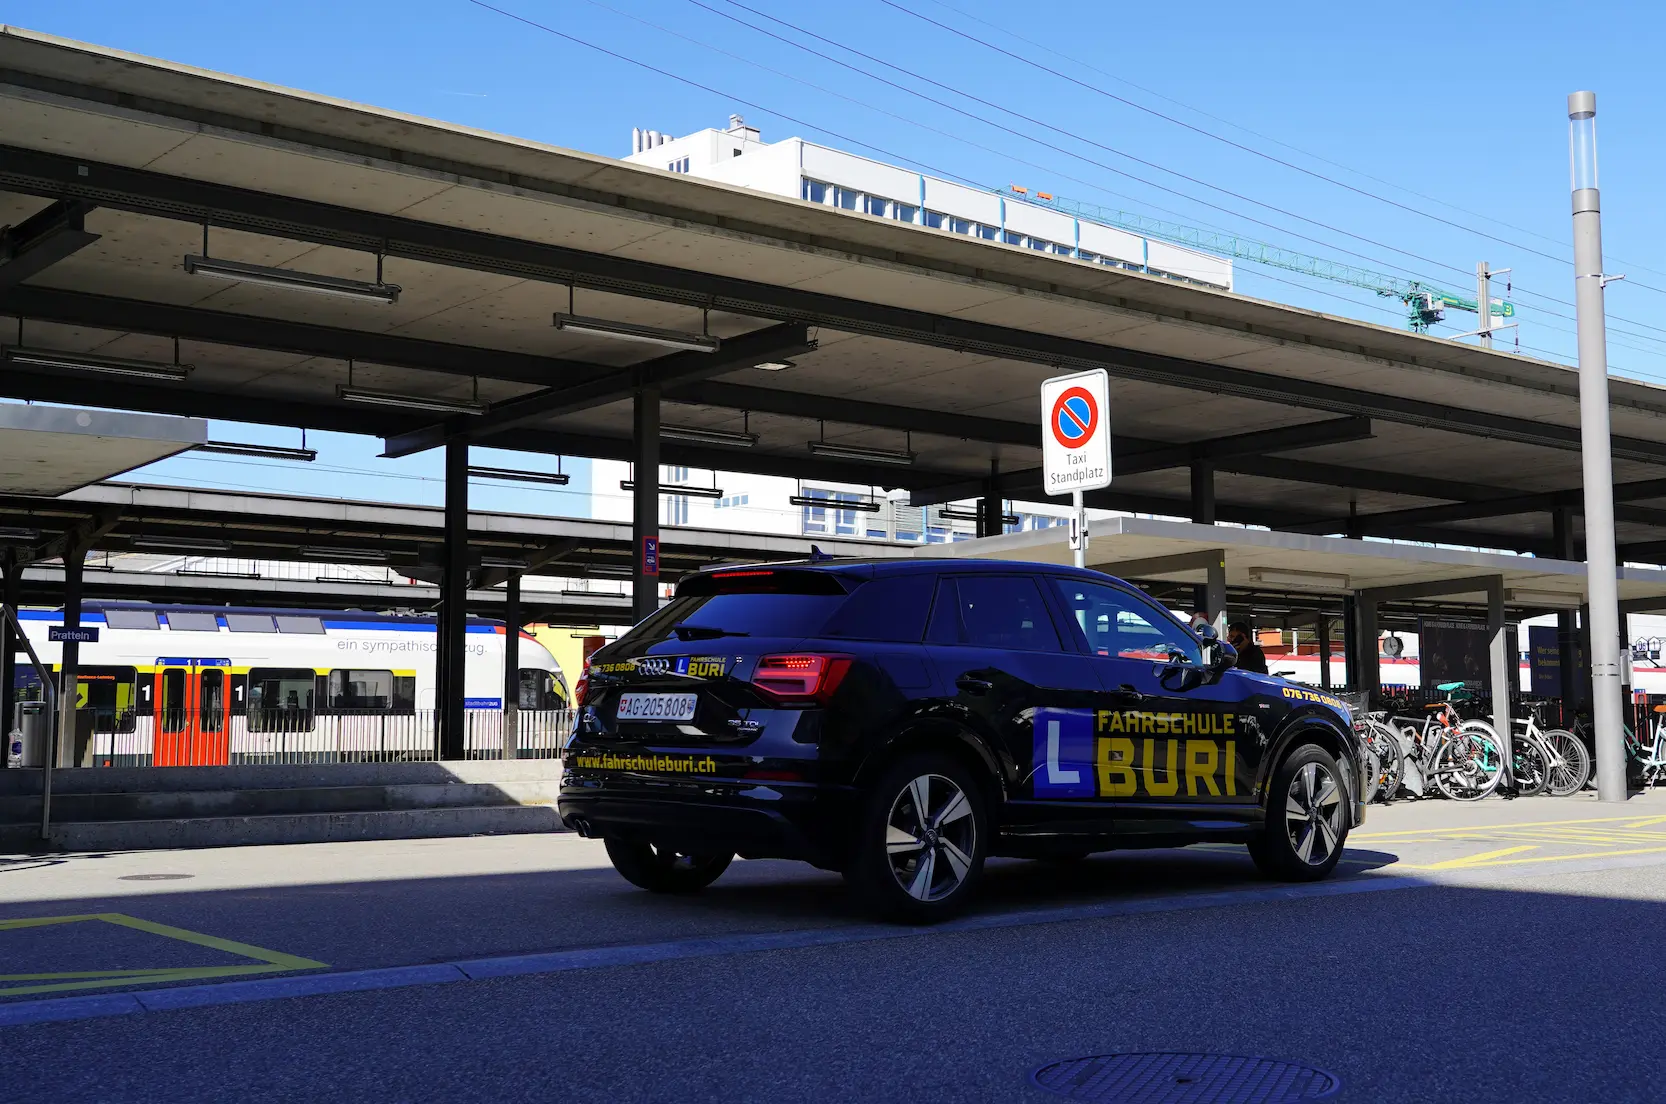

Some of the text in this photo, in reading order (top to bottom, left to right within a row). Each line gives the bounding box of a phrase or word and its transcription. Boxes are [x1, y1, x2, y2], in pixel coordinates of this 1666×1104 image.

[1066, 451, 1087, 465] Taxi
[1050, 467, 1104, 485] Standplatz
[51, 631, 90, 640] Pratteln
[337, 639, 358, 649] ein
[362, 640, 437, 654] sympathisc
[602, 664, 614, 673] 736
[688, 662, 725, 677] BURI
[142, 685, 151, 701] 1
[235, 685, 243, 702] 1
[1283, 687, 1302, 699] 076
[1302, 691, 1321, 703] 736
[1097, 709, 1235, 734] FAHRSCHULE
[1047, 720, 1081, 784] L
[576, 754, 716, 773] www.fahrschuleburi.ch
[1096, 737, 1237, 797] BURI
